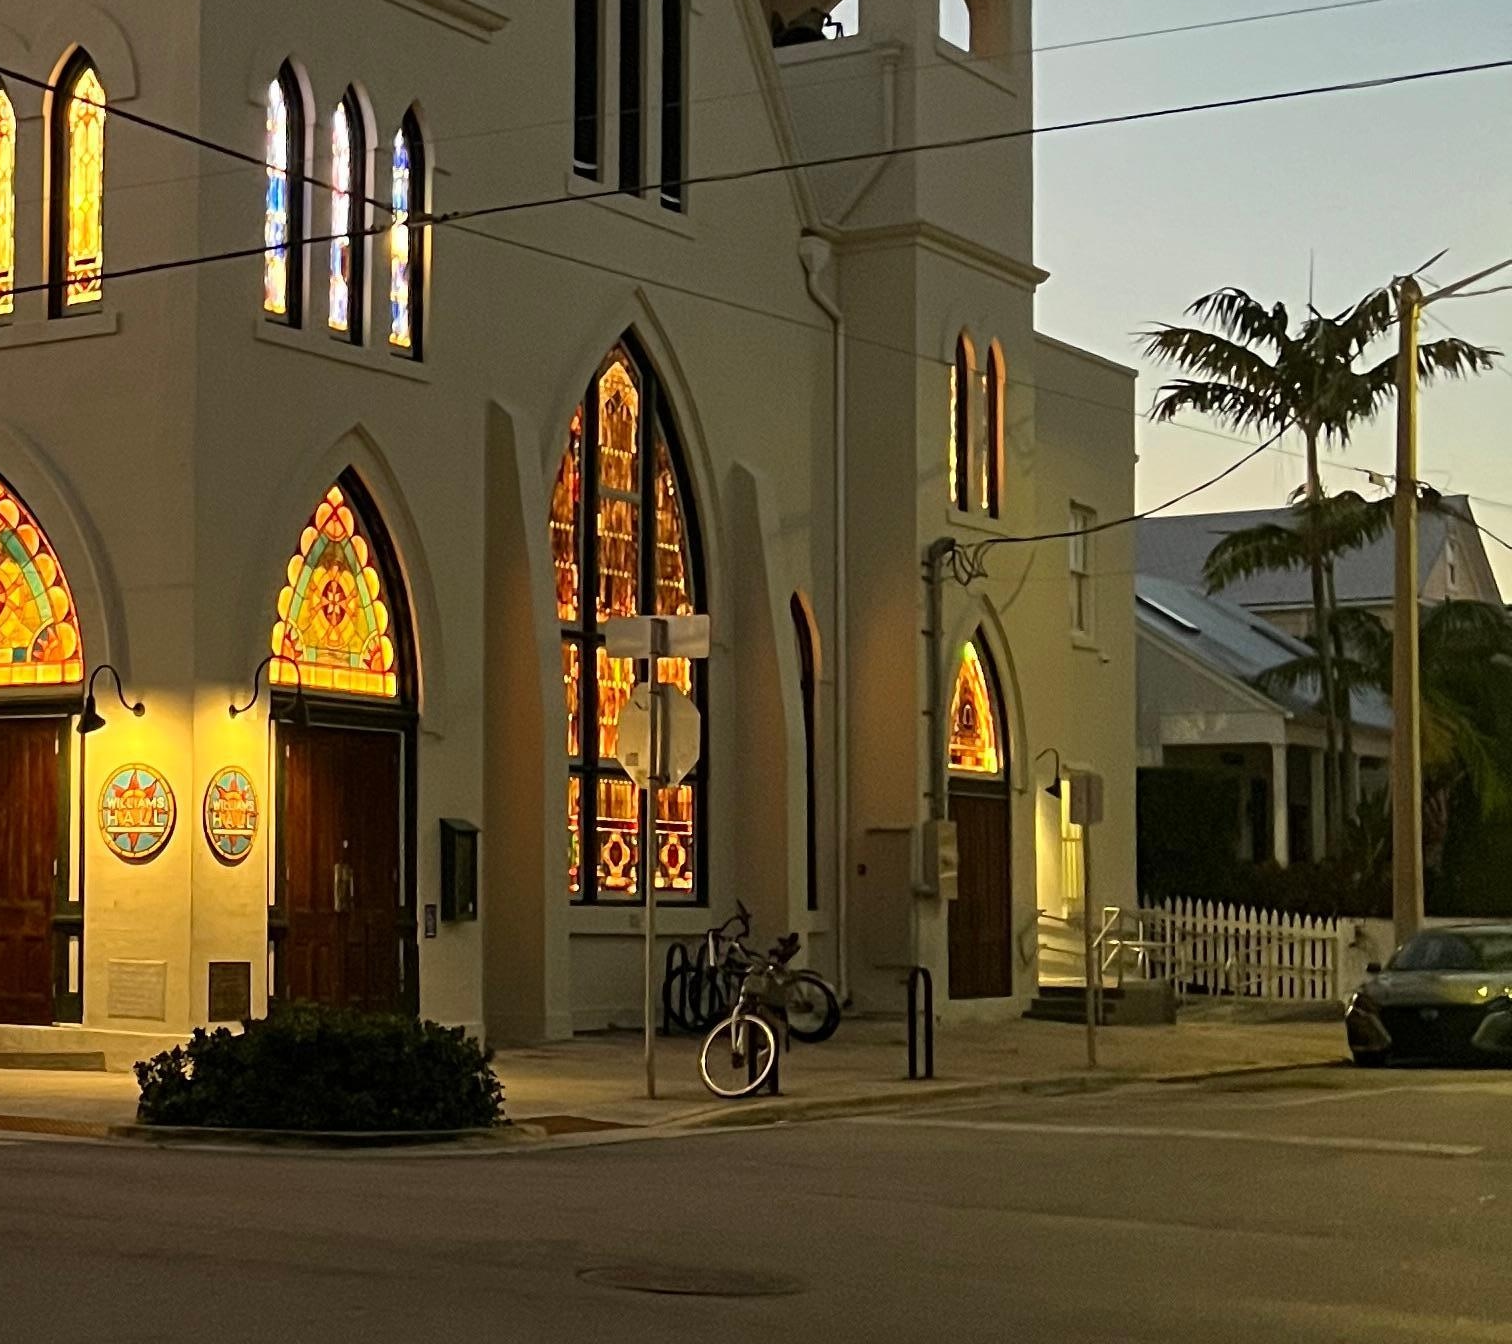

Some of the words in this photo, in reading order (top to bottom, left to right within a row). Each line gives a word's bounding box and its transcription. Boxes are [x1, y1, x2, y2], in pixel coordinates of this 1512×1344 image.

[107, 796, 165, 809] WILLIAMS
[213, 799, 255, 811] WILLIAMS
[107, 809, 165, 827] HALL
[212, 811, 255, 829] HALL
